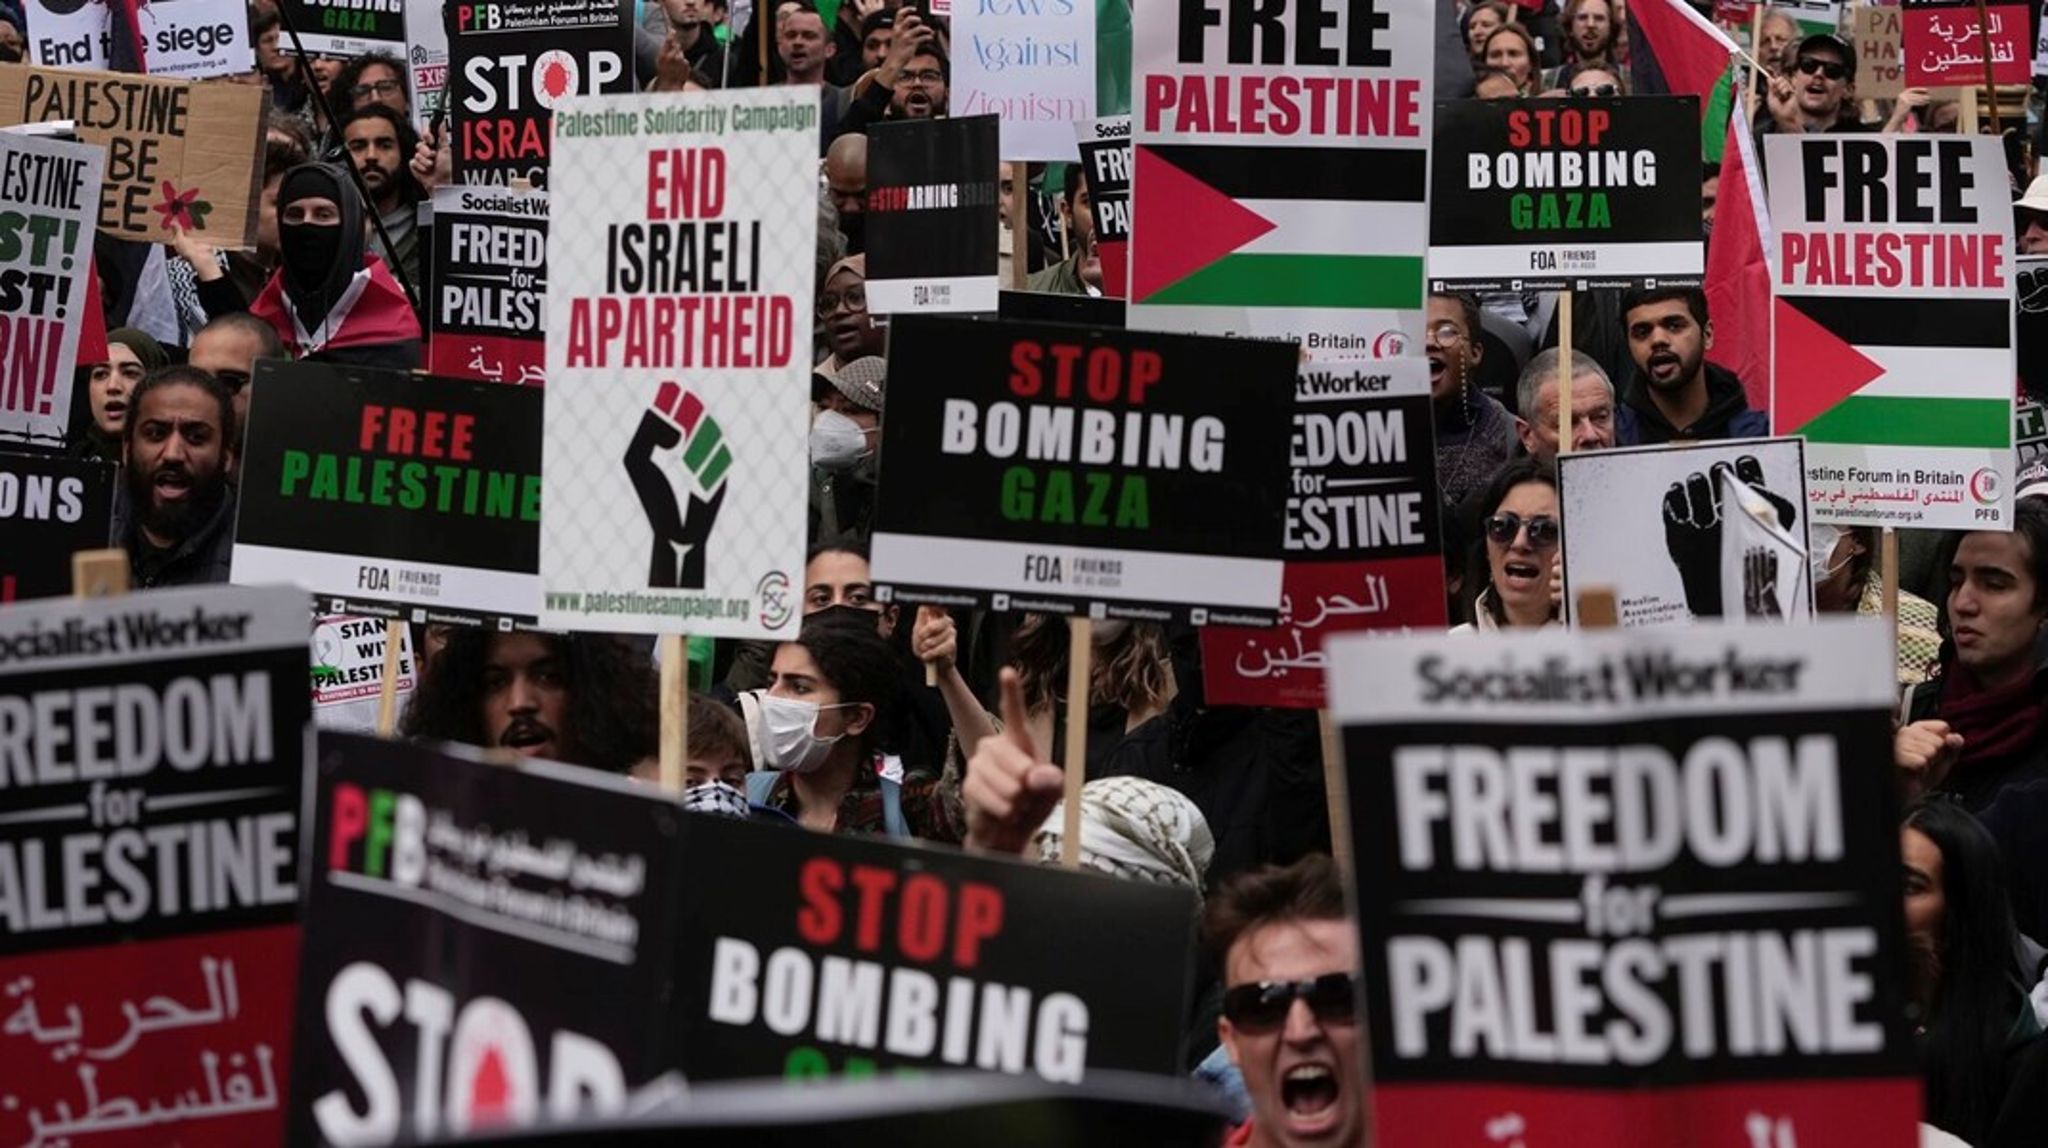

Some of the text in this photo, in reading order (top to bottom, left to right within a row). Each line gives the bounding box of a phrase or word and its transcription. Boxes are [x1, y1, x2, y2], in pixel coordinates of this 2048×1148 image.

[39, 34, 92, 65] End
[156, 23, 234, 56] siege
[322, 8, 376, 31] GAZA
[459, 5, 501, 32] PFB
[1178, 0, 1392, 67] FREE
[973, 34, 1079, 71] Against
[24, 74, 188, 137] PALESTINE
[463, 49, 622, 113] STOP
[1145, 74, 1420, 137] PALESTINE
[463, 120, 551, 161] ISRA
[556, 103, 816, 138] Palestine Solidarity Campaign
[1508, 109, 1611, 148] STOP
[2, 150, 87, 210] ESTINE
[108, 136, 159, 183] BE
[647, 147, 726, 220] END
[1468, 150, 1657, 189] BOMBING
[1801, 139, 1979, 224] FREE
[461, 193, 530, 215] Socialist
[1510, 193, 1612, 230] GAZA
[510, 268, 535, 288] for
[606, 220, 761, 293] ISRAELI
[1530, 251, 1557, 271] FOA
[1781, 232, 2005, 288] PALESTINE
[566, 296, 793, 368] APARTHEID
[1308, 332, 1366, 350] Britain
[1009, 340, 1163, 405] STOP
[1308, 370, 1392, 396] Worker
[360, 405, 476, 461] FREE
[941, 398, 1226, 473] BOMBING
[280, 449, 542, 522] PALESTINE
[1001, 465, 1150, 530] GAZA
[1291, 469, 1327, 495] for
[1848, 467, 1893, 484] Forum
[1897, 469, 1910, 484] in
[1914, 470, 1965, 487] Britain
[1974, 508, 2000, 522] PFB
[358, 565, 390, 592] FOA
[1024, 555, 1063, 584] FOA
[124, 606, 251, 649] Worker
[545, 591, 752, 622] www.palestinecampaign.org
[1416, 646, 1804, 704] Socialist Worker
[0, 671, 274, 789] REEDOM
[89, 779, 144, 826] for
[1392, 734, 1846, 873] FREEDOM
[328, 780, 428, 888] PFB
[796, 856, 1006, 969] STOP
[1581, 873, 1660, 937] for
[708, 936, 1090, 1085] BOMBING
[1385, 926, 1886, 1066] PALESTINE
[312, 960, 628, 1148] STOP
